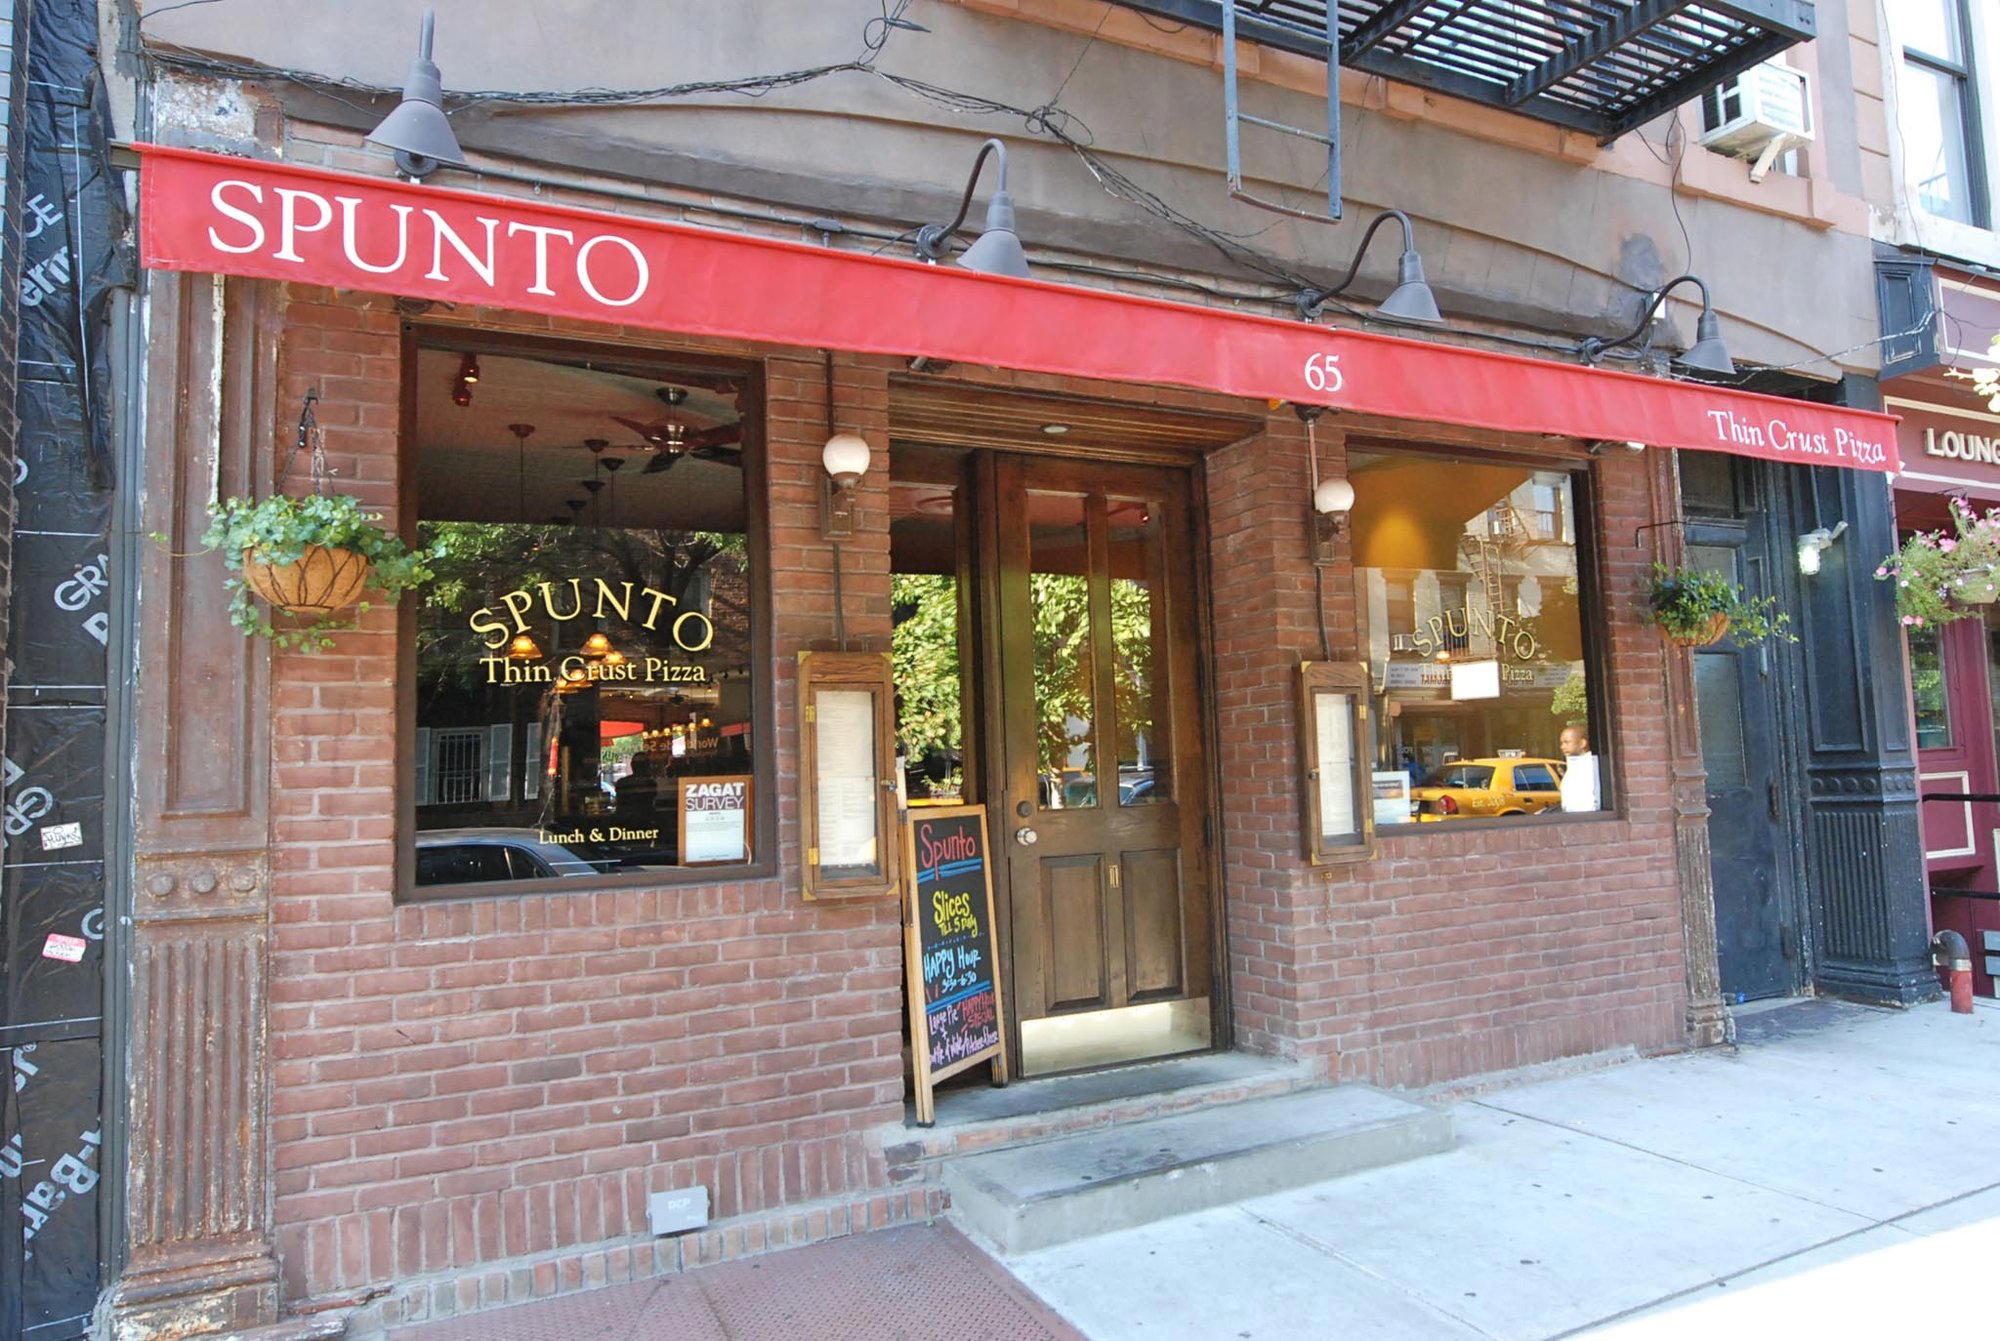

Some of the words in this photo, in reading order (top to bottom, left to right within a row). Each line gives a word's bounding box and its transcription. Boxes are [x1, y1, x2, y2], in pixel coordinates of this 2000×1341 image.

[207, 179, 650, 307] SPUNTO
[1304, 352, 1344, 393] 65
[1707, 410, 1765, 446] Thin
[1767, 419, 1829, 455] Crust
[1833, 426, 1887, 465] Pizza
[469, 577, 714, 653] SPUNTO
[1412, 607, 1535, 660] SPUNTO
[479, 656, 552, 684] Thin
[561, 655, 637, 682] Crust
[645, 656, 706, 683] Pizza
[1500, 662, 1533, 682] Pizza
[684, 796, 745, 812] SURVEY
[686, 782, 745, 798] ZAGAT
[538, 829, 585, 845] Lunch
[589, 828, 604, 843] &
[609, 826, 659, 841] Dinner
[920, 823, 976, 881] Spunto
[932, 890, 970, 925] Slices
